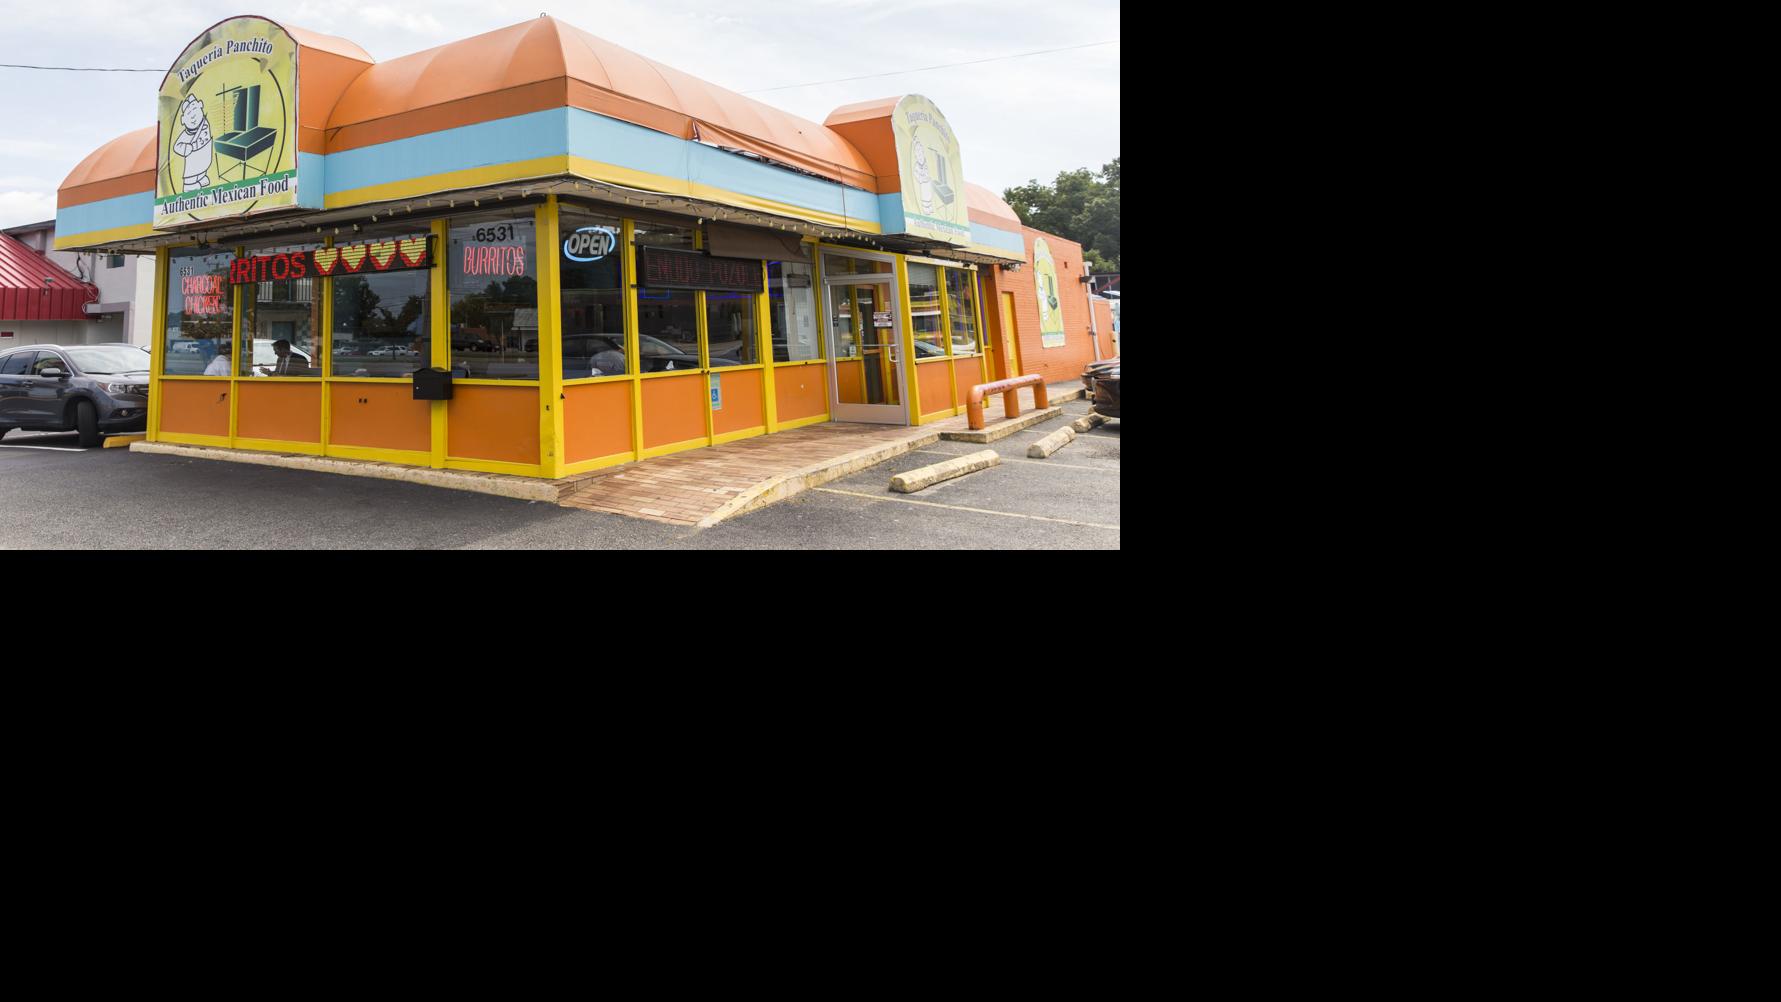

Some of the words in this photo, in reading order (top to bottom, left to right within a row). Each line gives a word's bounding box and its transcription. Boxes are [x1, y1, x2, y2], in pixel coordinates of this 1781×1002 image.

[177, 45, 223, 83] Taqueria
[226, 38, 273, 55] Panchito
[161, 191, 209, 216] Authentic
[211, 184, 256, 205] Mexican
[260, 174, 289, 195] Food
[476, 223, 514, 243] 6531
[567, 232, 611, 257] OPEN
[180, 266, 194, 277] 6531
[463, 246, 525, 276] BURRITOS
[181, 275, 224, 295] CHARCOAL
[185, 295, 221, 316] CHICKEN
